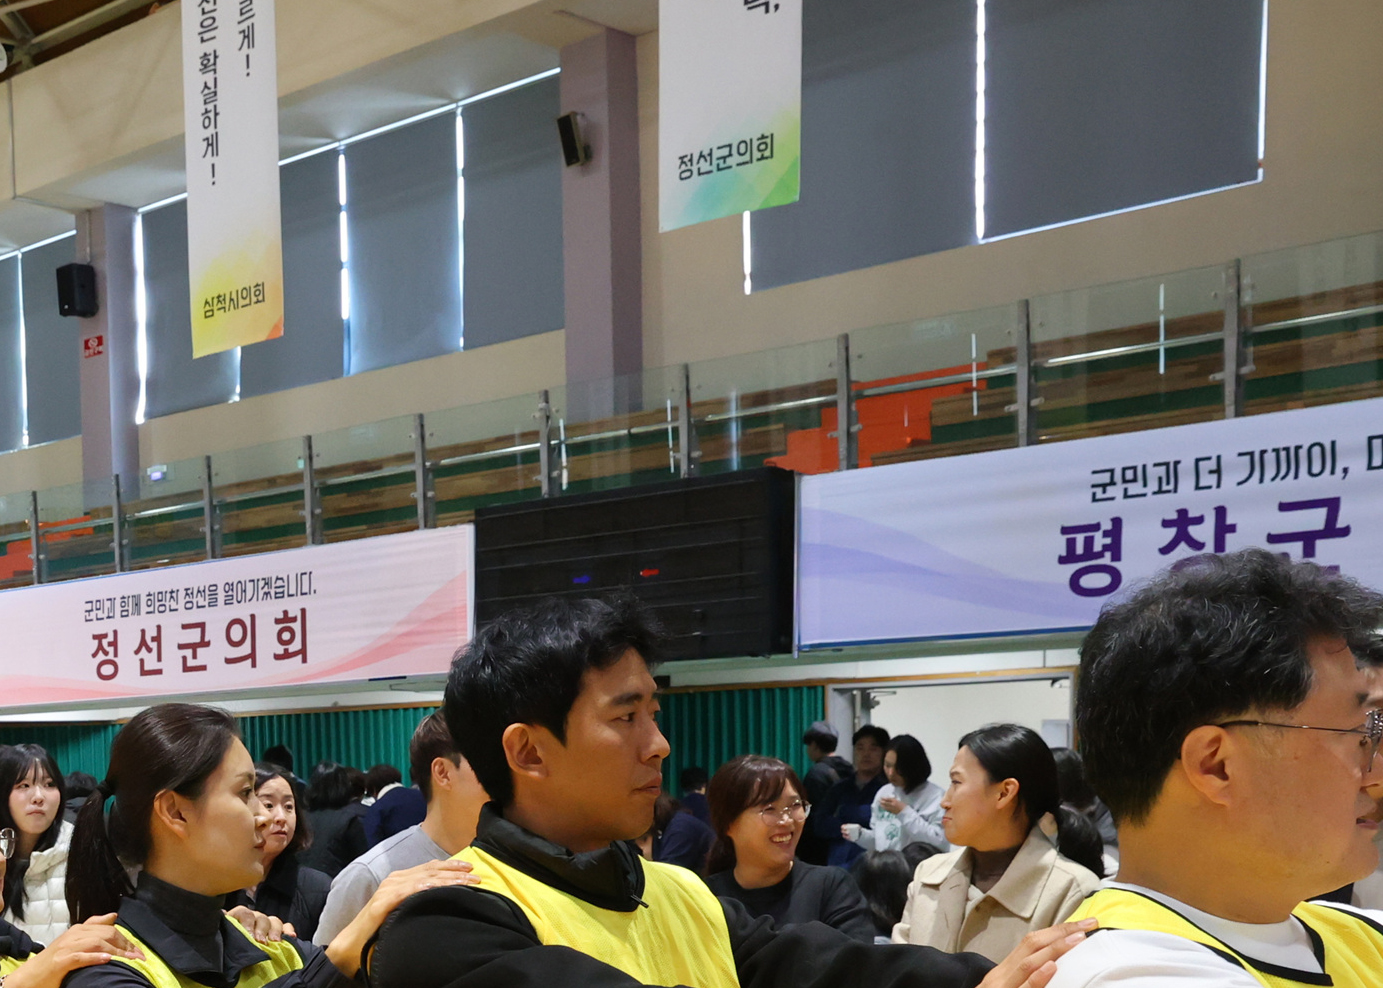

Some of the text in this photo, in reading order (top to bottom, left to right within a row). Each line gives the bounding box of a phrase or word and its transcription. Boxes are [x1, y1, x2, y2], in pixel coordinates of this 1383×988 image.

[198, 49, 220, 186] 확실하게!
[678, 133, 774, 181] 정선군의회
[202, 282, 266, 320] 삼척시의회
[1091, 460, 1181, 503] 군민과
[1194, 456, 1223, 492] 더
[1237, 440, 1351, 486] 가까이,
[84, 571, 317, 623] 군민과 함께 희망찬 정선을 열어가겠습니다.
[90, 608, 309, 682] 정선군의회
